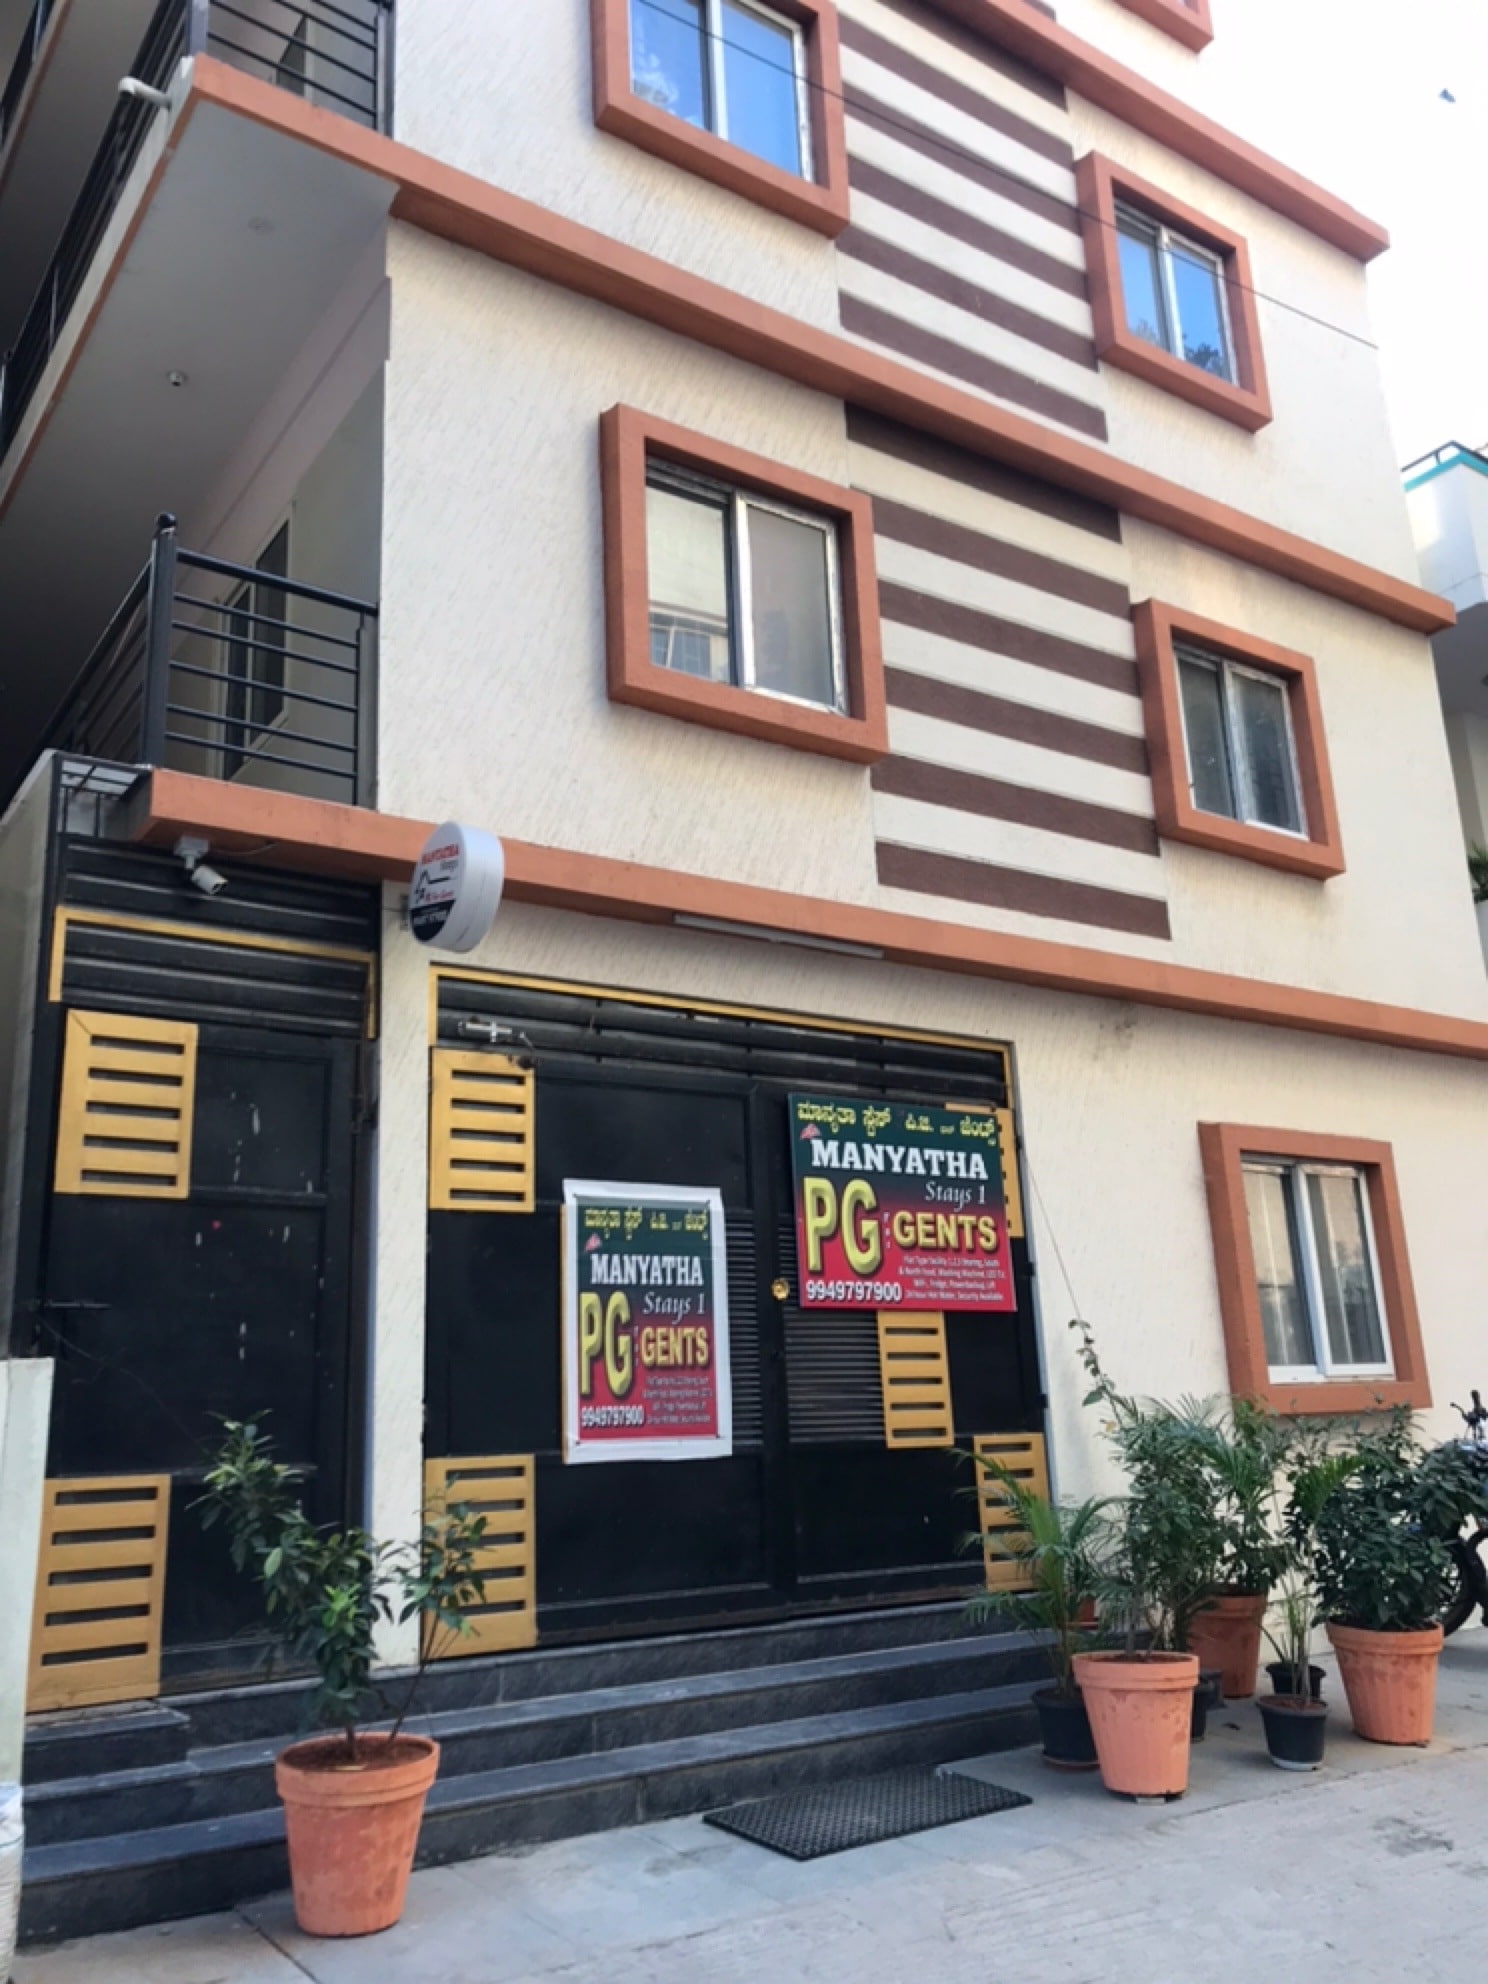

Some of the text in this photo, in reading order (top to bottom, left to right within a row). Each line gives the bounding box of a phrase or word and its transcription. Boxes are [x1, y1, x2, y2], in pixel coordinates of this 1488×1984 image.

[811, 1139, 988, 1180] MANYATHA
[925, 1181, 985, 1212] Stays 1
[803, 1177, 882, 1276] PG
[893, 1211, 998, 1251] GENTS
[590, 1253, 705, 1286] MANYATHA
[806, 1280, 902, 1302] 9949797900
[642, 1292, 705, 1325] Stays 1
[579, 1291, 633, 1396] PG
[640, 1326, 710, 1367] GENTS
[581, 1405, 645, 1428] 9949797900
